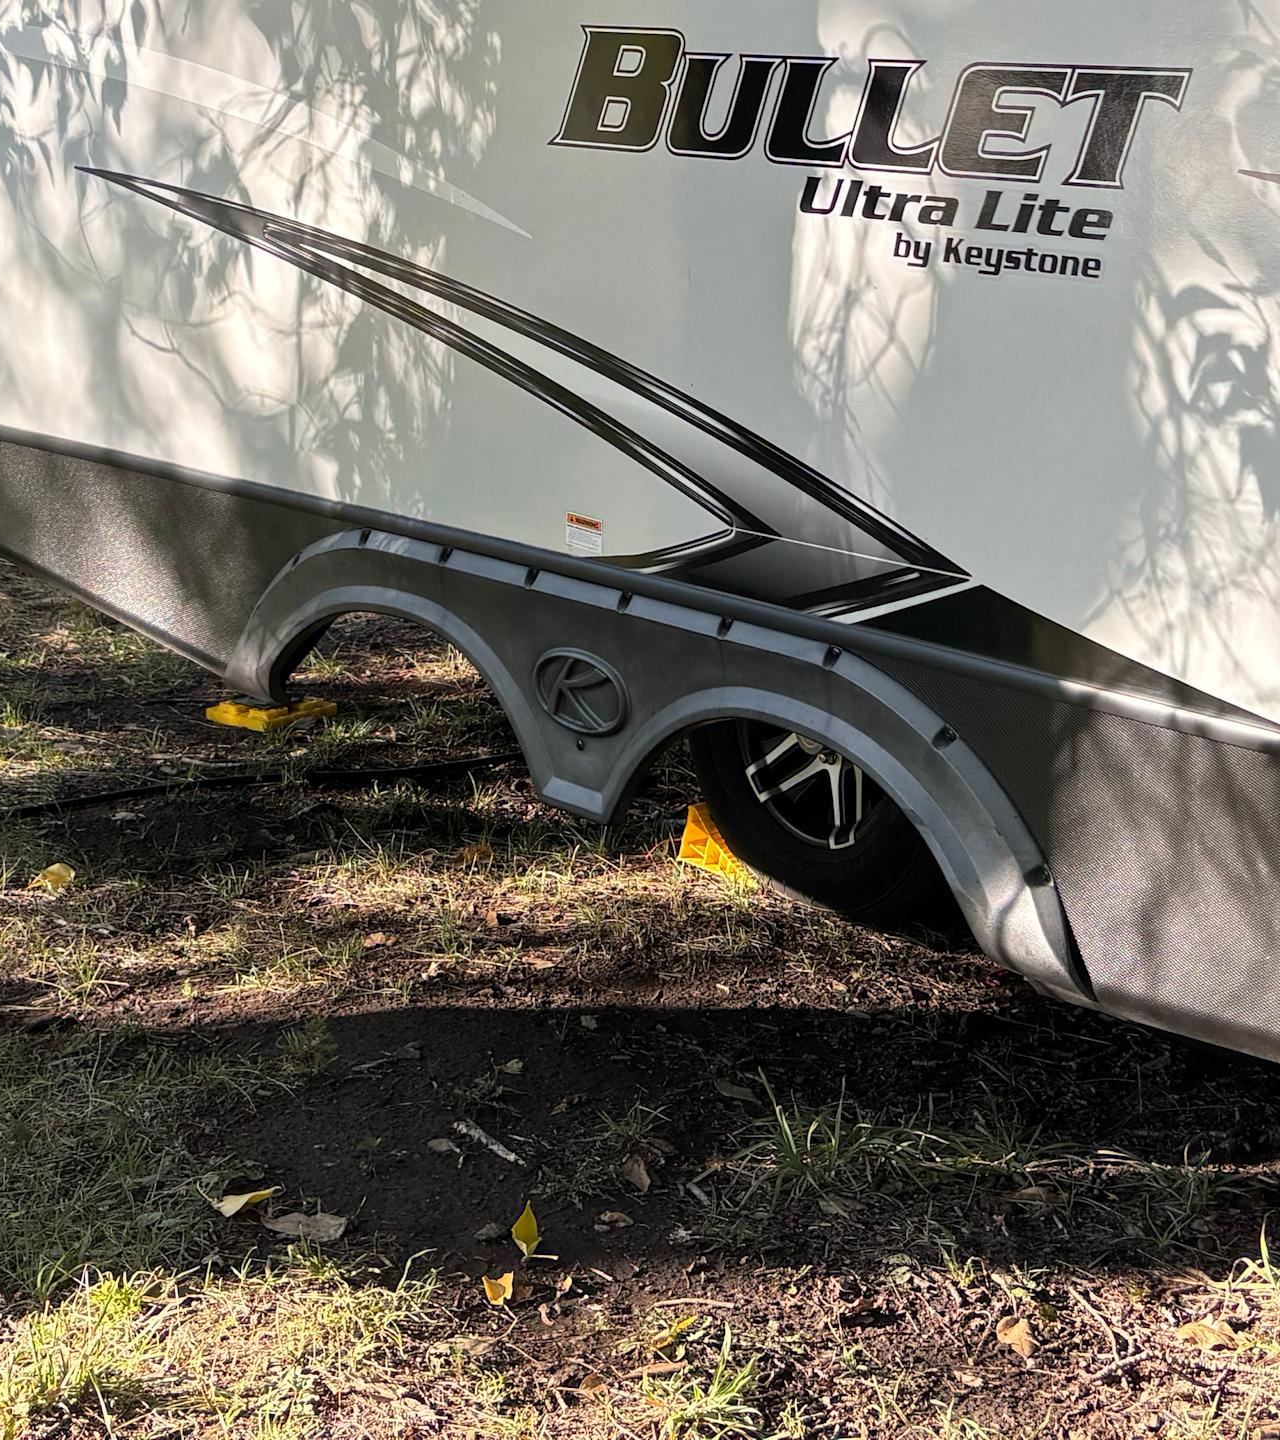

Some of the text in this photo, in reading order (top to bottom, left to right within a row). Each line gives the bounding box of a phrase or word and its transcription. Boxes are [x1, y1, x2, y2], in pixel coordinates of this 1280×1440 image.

[547, 25, 1193, 189] BULLET
[799, 176, 1114, 241] Ultra Lite
[893, 232, 1101, 279] by Keystone
